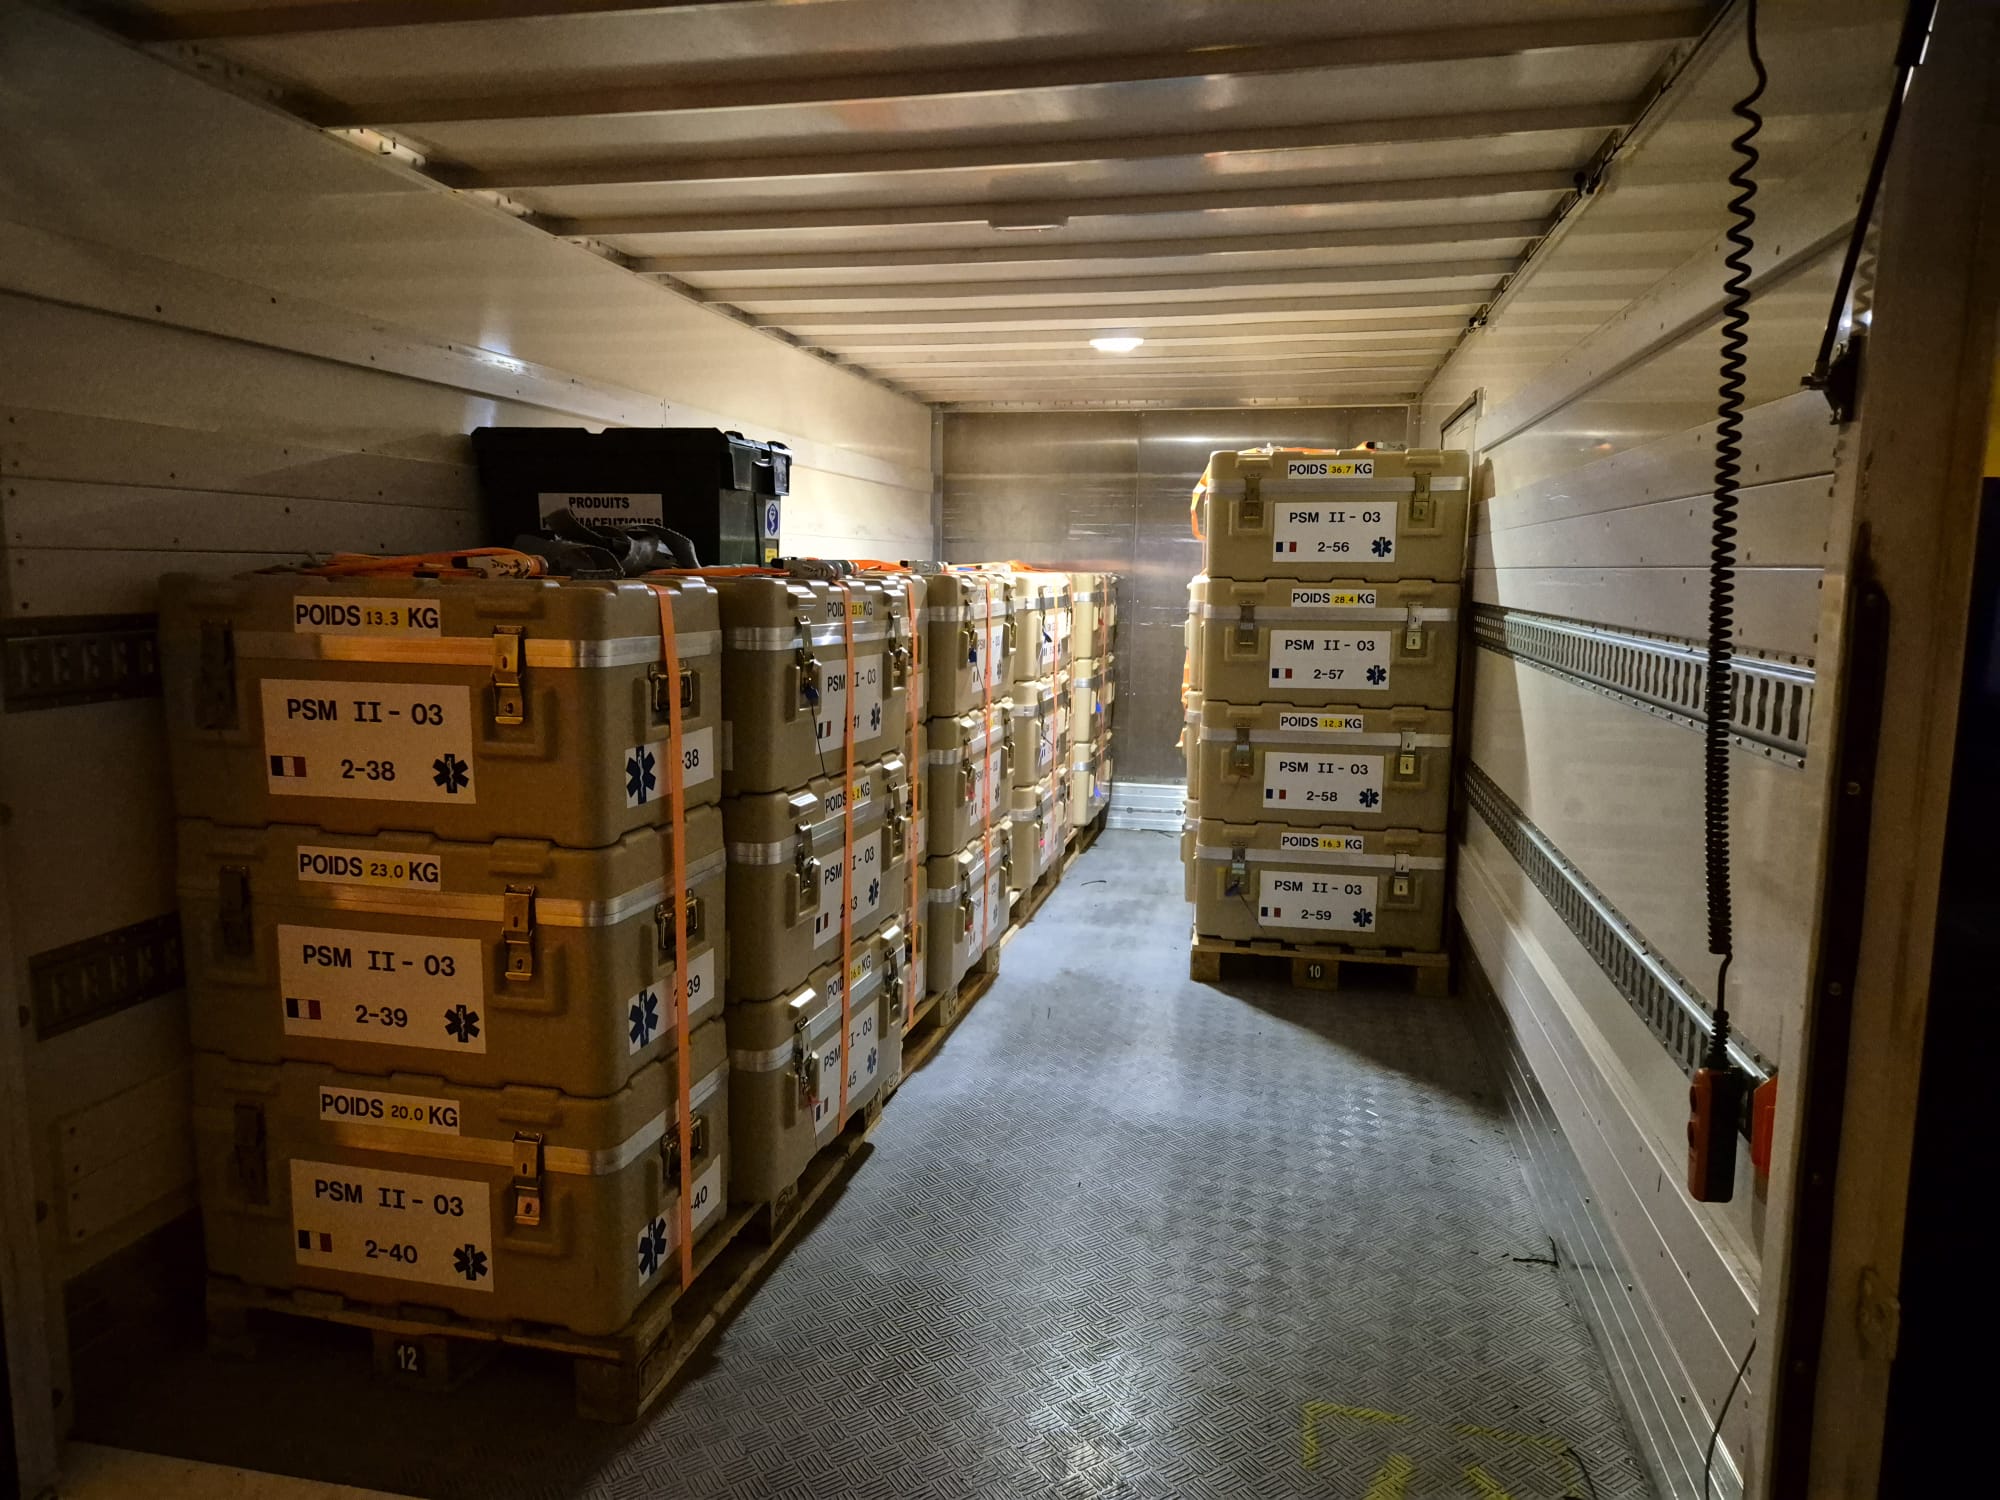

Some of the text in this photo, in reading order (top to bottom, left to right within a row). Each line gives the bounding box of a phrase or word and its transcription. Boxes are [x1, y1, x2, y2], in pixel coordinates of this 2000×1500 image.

[1289, 464, 1327, 475] POIDS
[1354, 464, 1372, 474] KG
[569, 498, 629, 508] PRODUITS
[1290, 512, 1319, 523] PSM
[1329, 512, 1345, 522] II
[1363, 512, 1380, 522] 03
[1318, 542, 1349, 552] 2-56
[1292, 593, 1330, 604] POIDS
[1358, 594, 1374, 604] KG
[296, 604, 439, 629] POIDS 13.3 KG
[827, 602, 844, 617] POID
[864, 602, 872, 616] KG
[1285, 640, 1314, 650] PSM
[1324, 640, 1339, 650] II
[1357, 641, 1374, 651] 03
[827, 675, 845, 692] PSM
[868, 669, 876, 684] 03
[1314, 669, 1344, 679] 2-57
[287, 699, 337, 720] PSM
[353, 701, 382, 722] II
[412, 703, 443, 725] 03
[1281, 717, 1318, 728] POIDS
[1344, 719, 1362, 729] KG
[341, 759, 395, 781] 2-38
[1280, 762, 1308, 772] PSM
[1318, 763, 1333, 773] II
[1351, 764, 1368, 774] 03
[861, 782, 870, 797] KG
[1307, 791, 1337, 801] 2-58
[1282, 837, 1318, 848] POIDS
[1345, 840, 1362, 850] KG
[299, 853, 438, 884] POIDS 23.0 KG
[825, 863, 843, 886] PSM
[865, 846, 875, 864] 03
[1275, 881, 1302, 891] PSM
[1312, 883, 1327, 893] II
[1345, 884, 1362, 895] 03
[1302, 910, 1331, 920] 2-59
[303, 945, 351, 968] PSM
[368, 948, 396, 971] II
[424, 955, 455, 976] 03
[828, 976, 843, 1000] POID
[861, 955, 870, 971] KG
[1309, 965, 1321, 978] 10
[355, 1005, 407, 1027] 2-39
[863, 1017, 872, 1036] 03
[321, 1095, 457, 1127] POIDS 20.0 KG
[315, 1180, 362, 1203] PSM
[379, 1188, 405, 1209] II
[434, 1195, 463, 1216] 03
[365, 1240, 417, 1263] 2-40
[397, 1345, 418, 1372] 12
